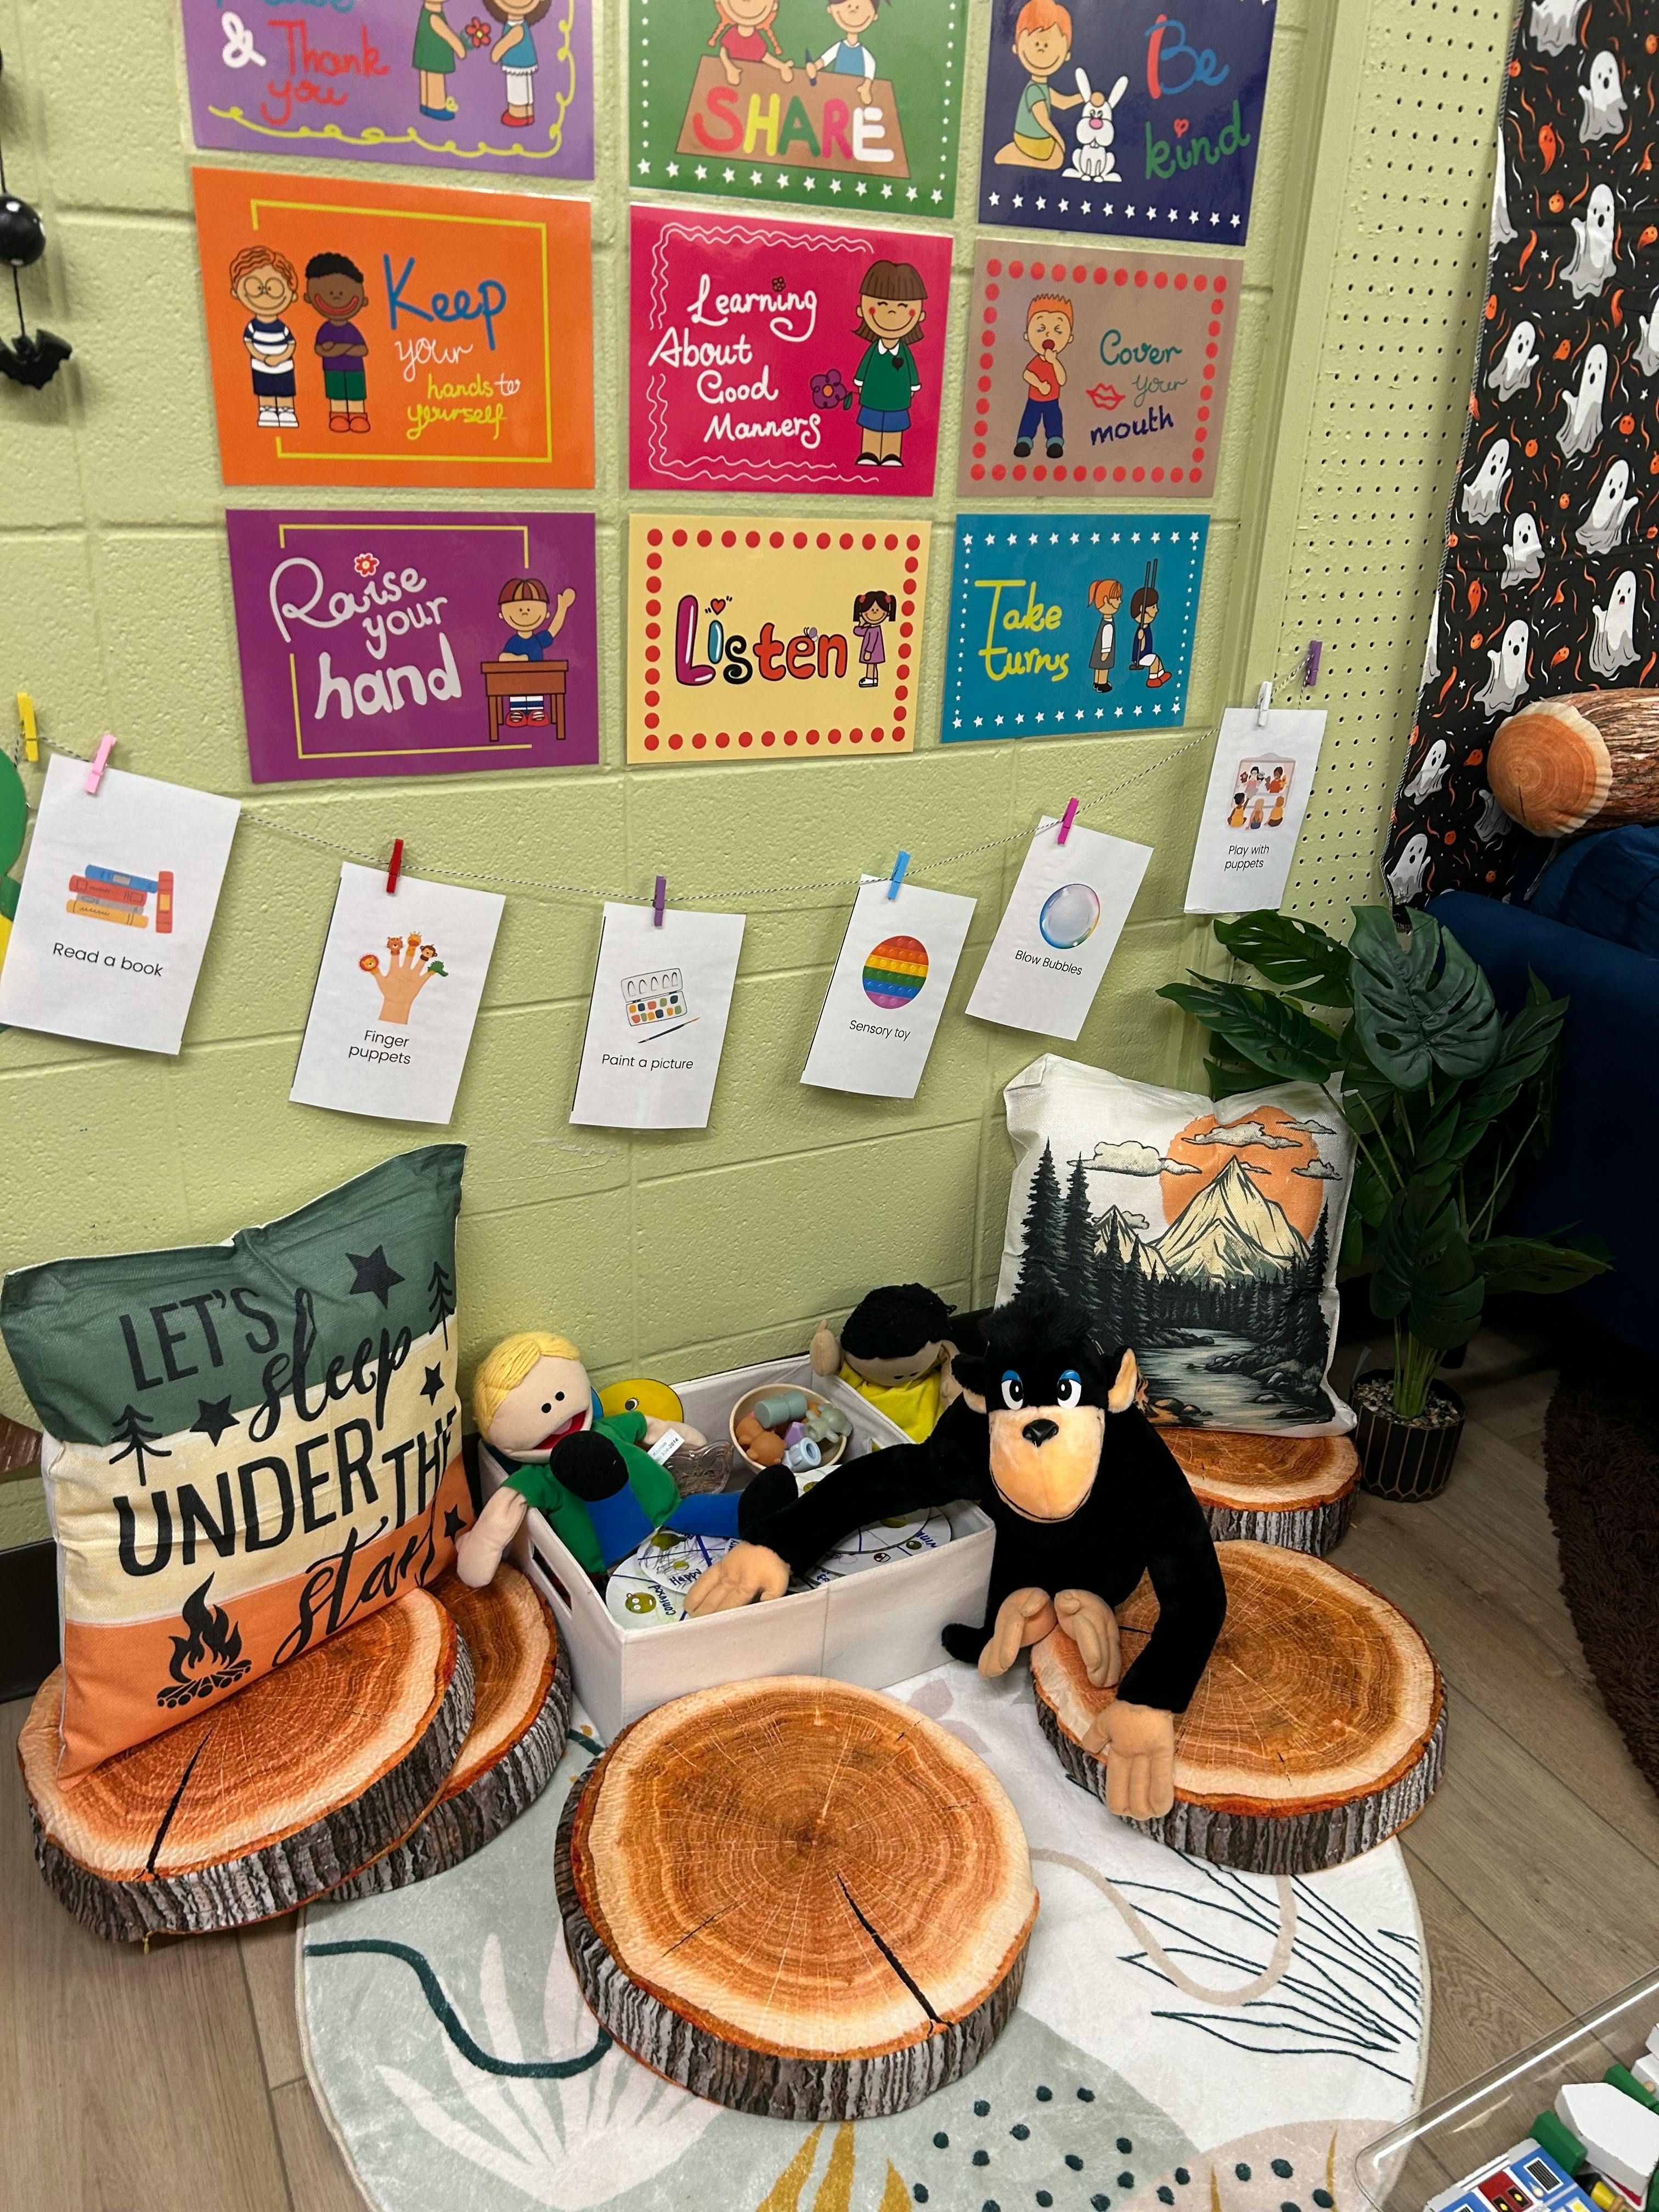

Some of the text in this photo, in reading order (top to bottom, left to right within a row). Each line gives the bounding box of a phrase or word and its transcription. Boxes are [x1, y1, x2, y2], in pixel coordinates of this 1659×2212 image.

[222, 11, 390, 77] & Thank
[1144, 14, 1229, 99] Be
[260, 79, 348, 126] you
[692, 87, 894, 162] SHARE
[1145, 99, 1251, 179] kind
[383, 253, 506, 351] Keep
[687, 274, 817, 342] Learning
[394, 338, 473, 382] your
[648, 326, 753, 367] About
[1100, 329, 1182, 366] Cover
[428, 373, 521, 400] hands to
[697, 365, 778, 404] Good
[1132, 374, 1188, 408] your
[407, 403, 507, 440] yourself
[704, 413, 821, 449] Manners
[1091, 405, 1174, 446] mouth
[269, 556, 427, 643] Raise
[974, 579, 1063, 652] Take
[363, 597, 448, 660] your
[675, 595, 848, 686] Listen
[314, 632, 462, 719] hand
[979, 647, 1069, 681] turns
[1224, 859, 1264, 871] puppets
[1228, 844, 1269, 857] Play with
[52, 943, 164, 977] Read a book
[1015, 950, 1083, 975] Blow Bubbles
[364, 1030, 410, 1048] Finger
[849, 1020, 911, 1041] Sensory toy
[348, 1045, 411, 1065] puppets
[601, 1053, 694, 1071] Paint a picture
[119, 1287, 279, 1391] LET'S
[248, 1287, 411, 1442] sleep
[113, 1418, 379, 1576] UNDER
